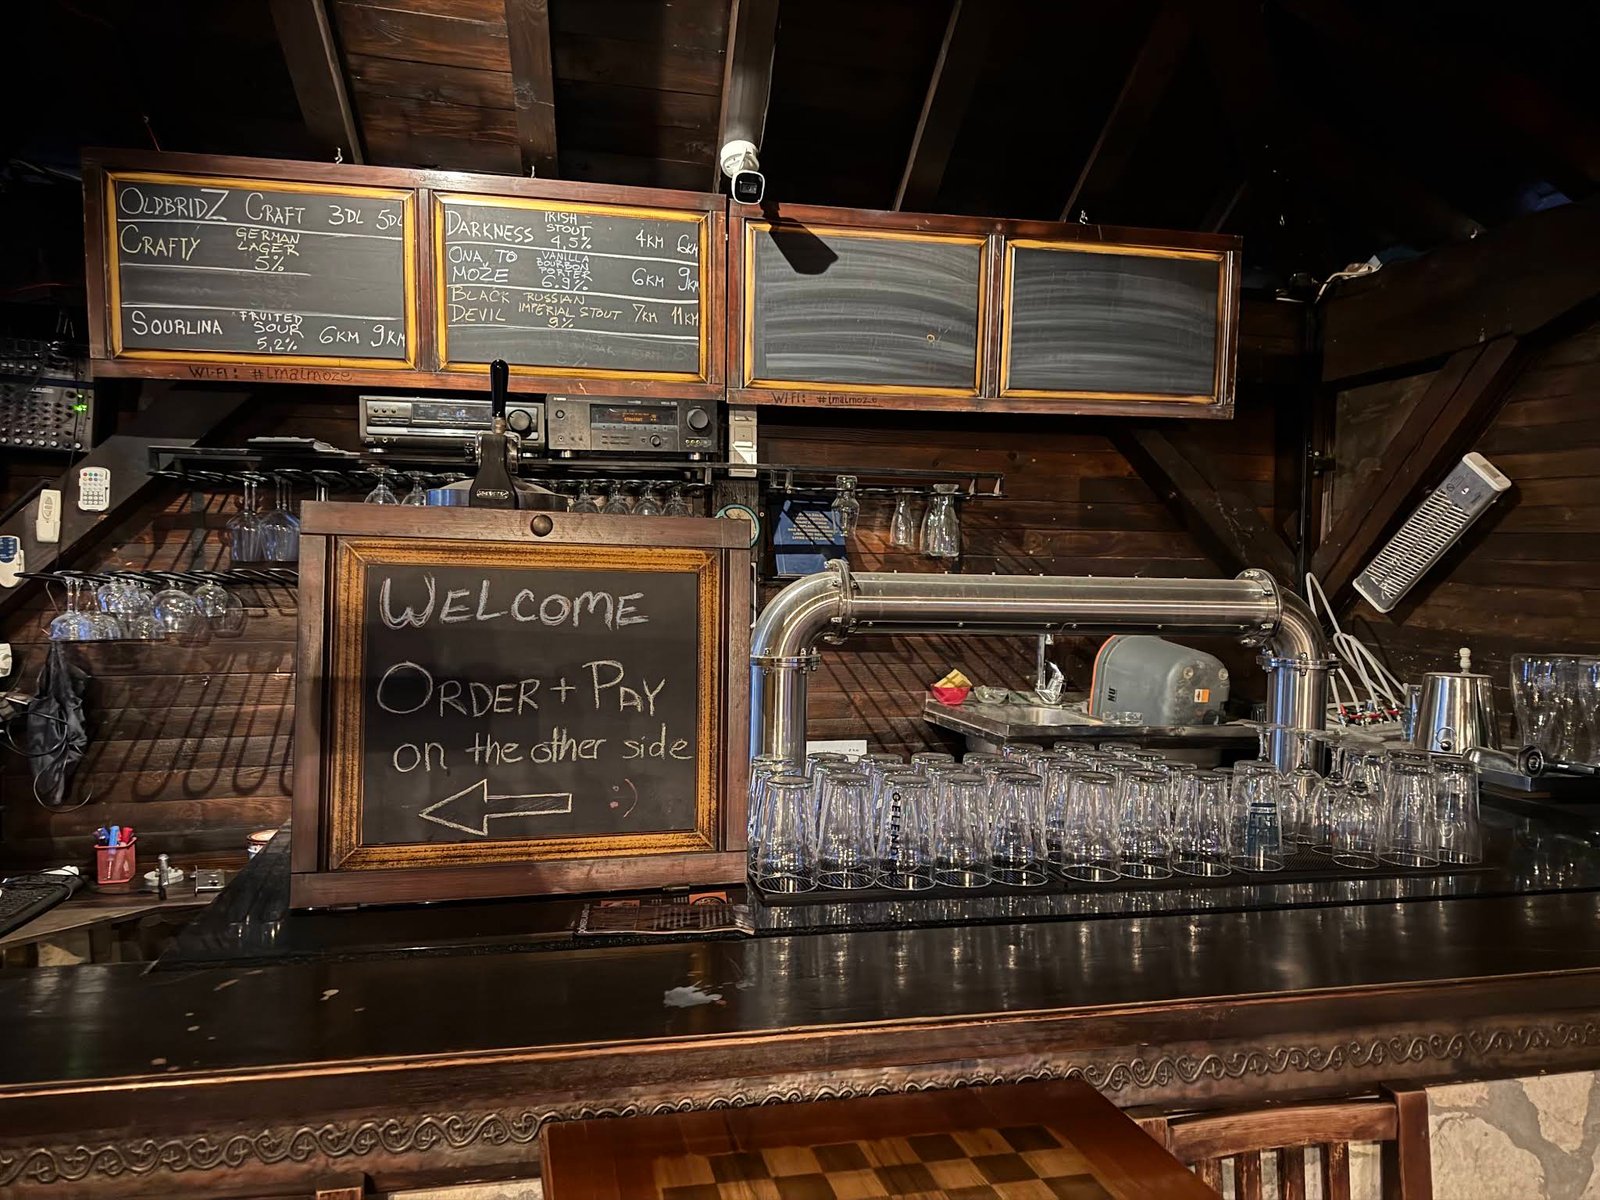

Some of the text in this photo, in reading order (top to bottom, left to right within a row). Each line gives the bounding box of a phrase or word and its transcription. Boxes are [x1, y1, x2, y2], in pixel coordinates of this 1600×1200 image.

[245, 192, 306, 225] CRAFT
[328, 204, 364, 225] 3DL
[543, 210, 578, 225] IRISH
[235, 227, 300, 245] GERMAN
[445, 210, 534, 243] DARKNESS
[546, 223, 594, 238] STOUT
[119, 224, 201, 261] CRAFTY
[635, 228, 665, 249] 4KM
[237, 242, 300, 257] LAGER
[448, 245, 519, 264] ONA TO
[541, 250, 590, 263] VANILLA
[254, 254, 285, 272] 5%
[452, 261, 510, 283] MOŽE
[536, 257, 590, 272] BOURBON
[538, 266, 593, 282] PORTER
[541, 275, 589, 292] 6.9%
[631, 267, 665, 288] 6KM
[450, 284, 510, 304] BLACK
[522, 292, 586, 305] RUSSIAN
[240, 311, 304, 326] FRUITED
[447, 303, 507, 323] DEVIL
[518, 302, 623, 321] IMPERIAL STOUT
[632, 303, 659, 323] 7KM
[131, 310, 224, 336] SOURLINA
[253, 321, 305, 339] SOUR
[547, 316, 574, 329] 9%
[318, 325, 361, 345] 6KM
[256, 336, 298, 354] 5,2%
[378, 571, 651, 630] WELCOME
[376, 660, 541, 718] ORDER
[582, 660, 666, 718] PAY
[392, 722, 694, 773] on the other side
